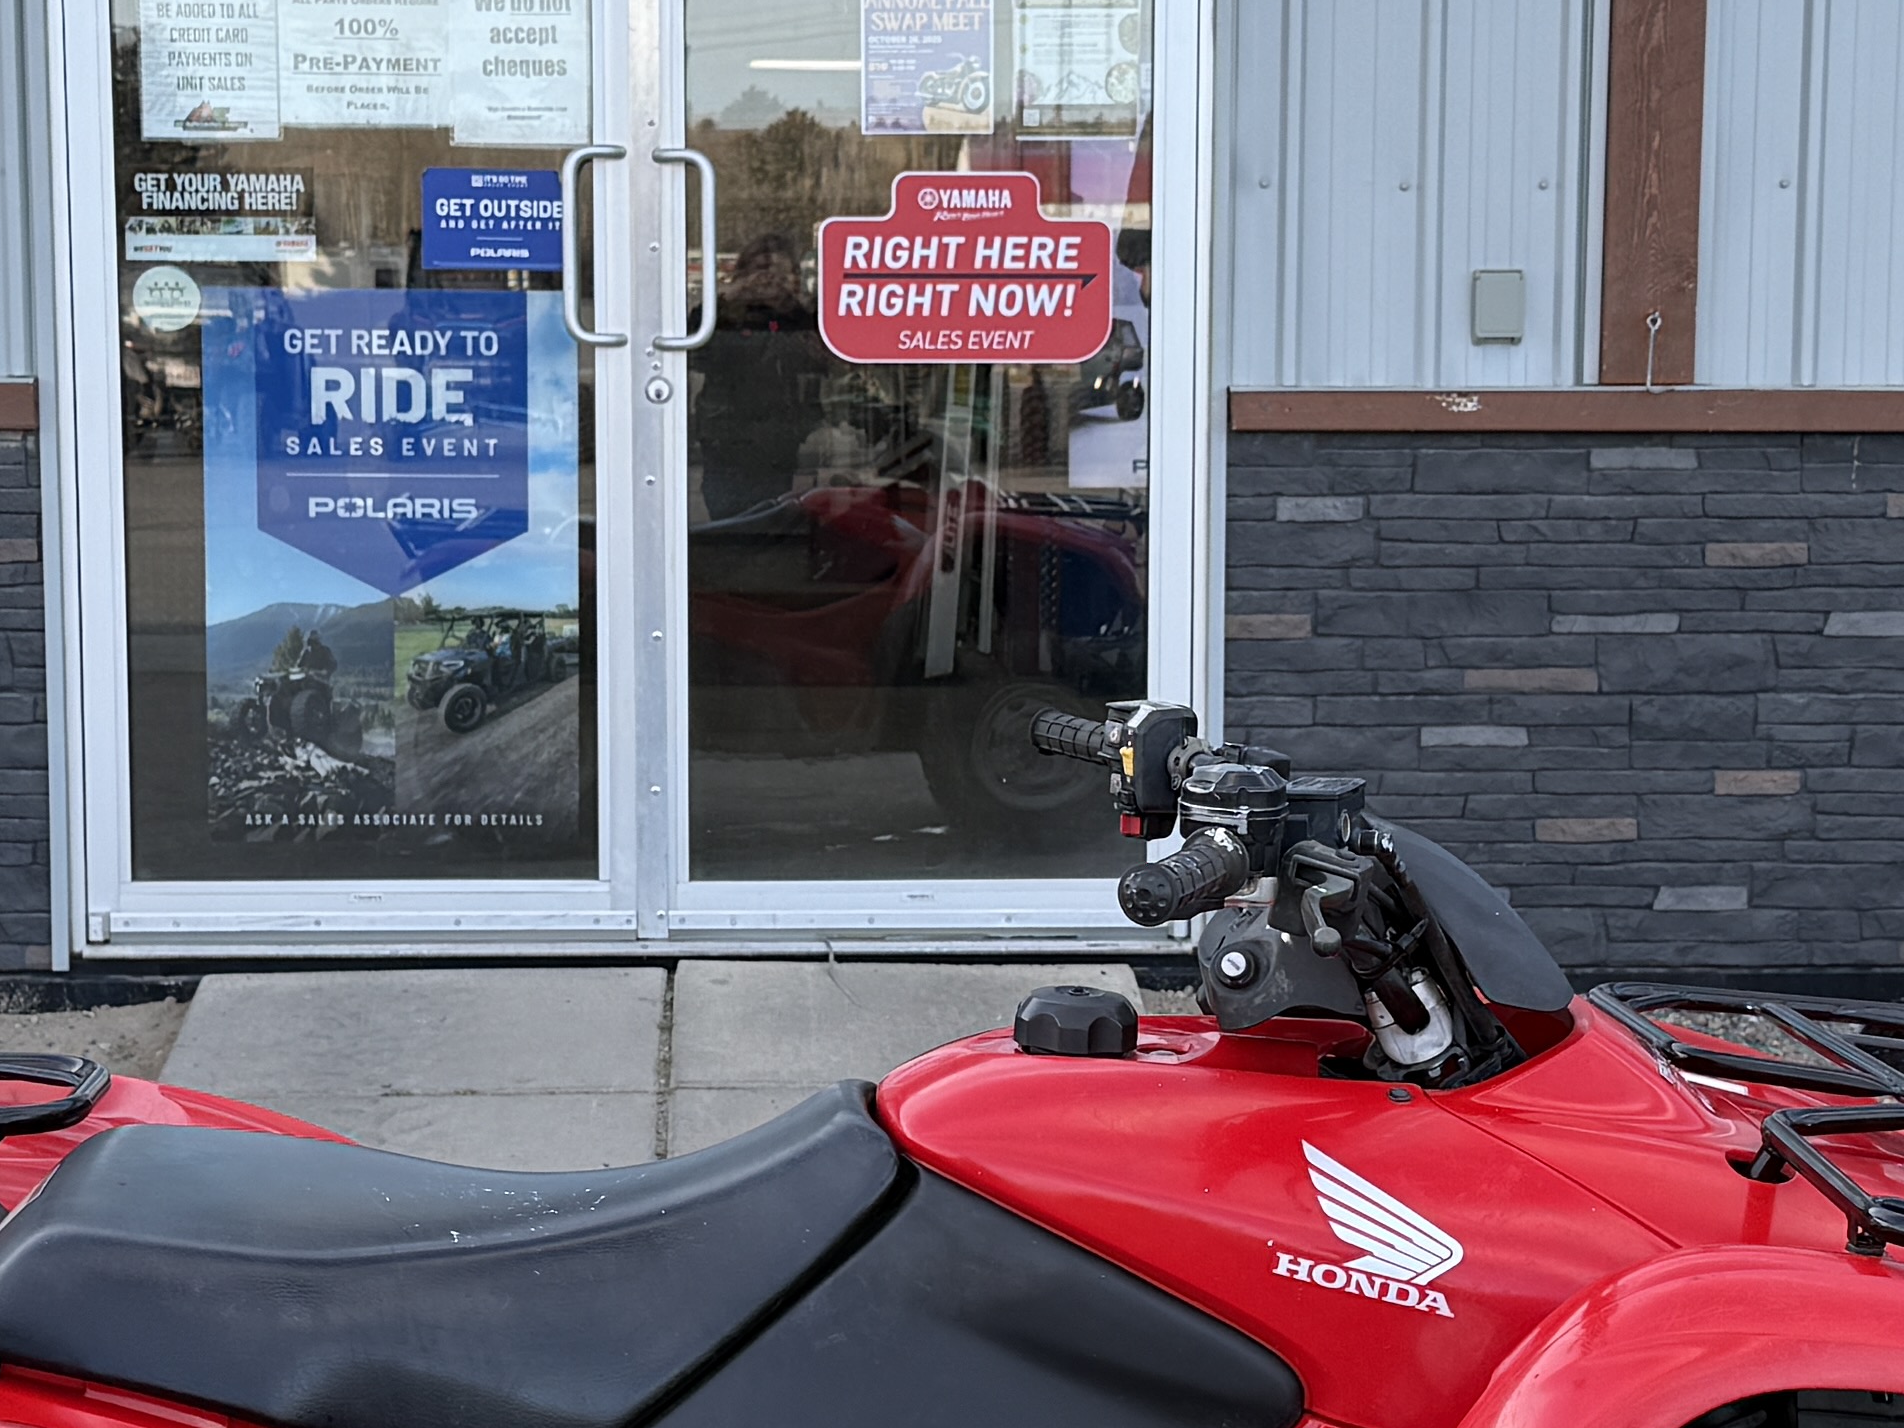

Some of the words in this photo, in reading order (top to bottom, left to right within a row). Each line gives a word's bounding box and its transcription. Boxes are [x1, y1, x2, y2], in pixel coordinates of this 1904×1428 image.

[156, 2, 172, 19] BE
[175, 2, 216, 19] ADDED
[220, 2, 235, 19] TO
[237, 2, 260, 19] ALL
[333, 17, 400, 39] 100%
[870, 11, 929, 32] SWAP
[931, 12, 984, 31] MEET
[169, 27, 213, 44] CREDIT
[215, 27, 249, 44] CARD
[489, 25, 559, 47] accept
[167, 51, 233, 68] PAYMENTS
[235, 52, 253, 68] ON
[292, 52, 442, 73] PRE-PAYMENT
[482, 55, 568, 79] cheques
[176, 75, 205, 93] UNIT
[207, 76, 247, 92] SALES
[133, 172, 170, 193] GET
[172, 172, 222, 193] YOUR
[226, 173, 305, 193] YAMAHA
[141, 192, 240, 211] FINANCING
[244, 192, 299, 211] HERE!
[435, 197, 476, 217] GET
[478, 198, 563, 219] OUTSIDE
[938, 188, 1012, 209] YAMAHA
[439, 219, 465, 229] AND
[471, 219, 495, 230] GET
[501, 220, 542, 231] AFTER
[470, 247, 530, 258] POLARIS
[843, 235, 966, 269] RIGHT
[973, 235, 1082, 270] HERE
[837, 283, 960, 317] RIGHT
[968, 283, 1077, 317] NOW!
[283, 328, 344, 355] GET
[350, 328, 453, 356] READY
[460, 330, 500, 357] TO
[898, 329, 963, 350] SALES
[967, 330, 1035, 350] EVENT
[310, 366, 474, 427] RIDE
[285, 437, 385, 456] SALES
[401, 437, 499, 457] EVENT
[308, 496, 479, 519] POLARIS
[245, 813, 274, 826] ASK
[281, 813, 290, 826] A
[297, 813, 345, 826] SALES
[353, 813, 436, 826] ASSOCIATE
[444, 813, 473, 826] FOR
[480, 813, 544, 826] DETAILS
[1271, 1251, 1456, 1319] HONDA
